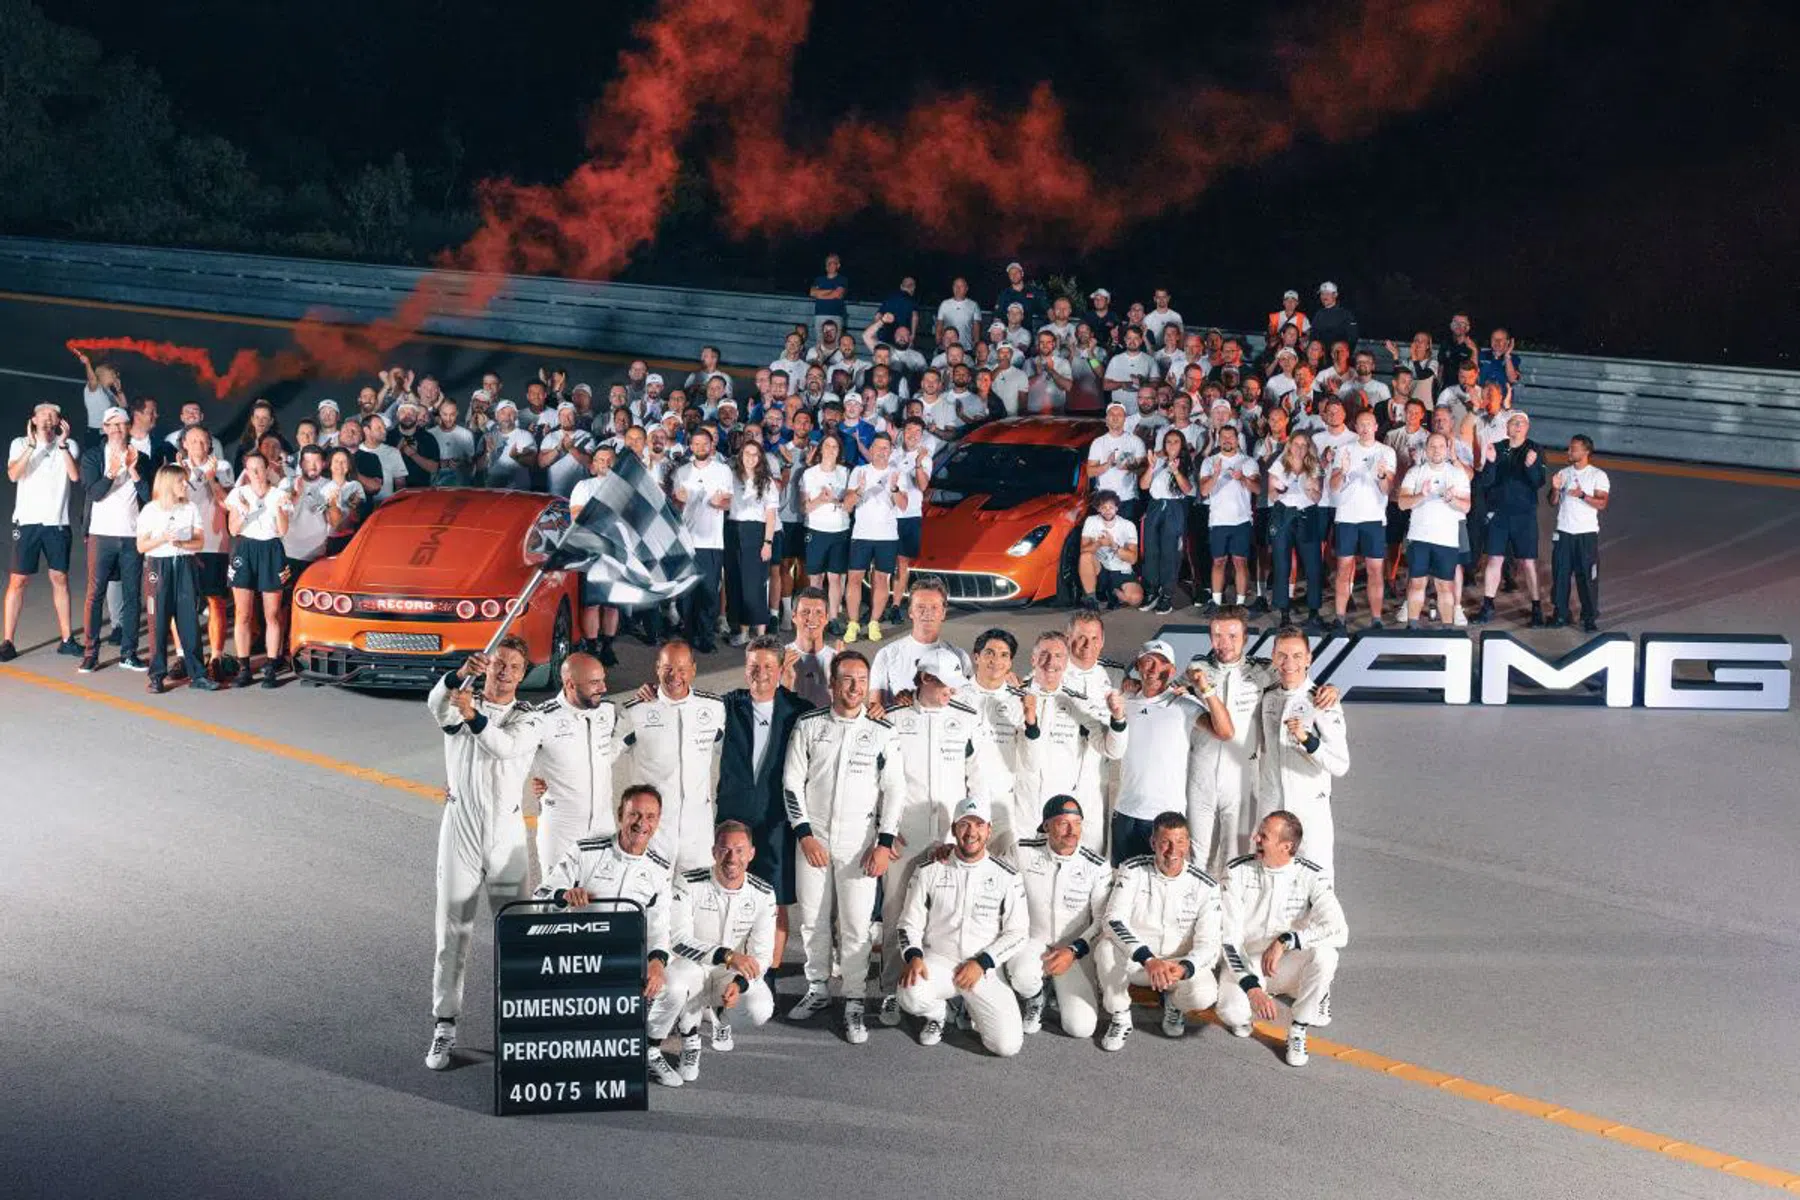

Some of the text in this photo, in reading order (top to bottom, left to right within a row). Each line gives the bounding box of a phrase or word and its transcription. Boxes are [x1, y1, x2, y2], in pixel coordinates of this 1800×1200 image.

[377, 599, 434, 611] RECORD
[1338, 632, 1792, 710] AMG
[553, 921, 611, 935] AMG
[540, 955, 603, 975] A NEW
[502, 996, 640, 1019] DIMENSION OF
[503, 1038, 641, 1061] PERFORMANCE
[510, 1080, 626, 1102] 40075 KM
